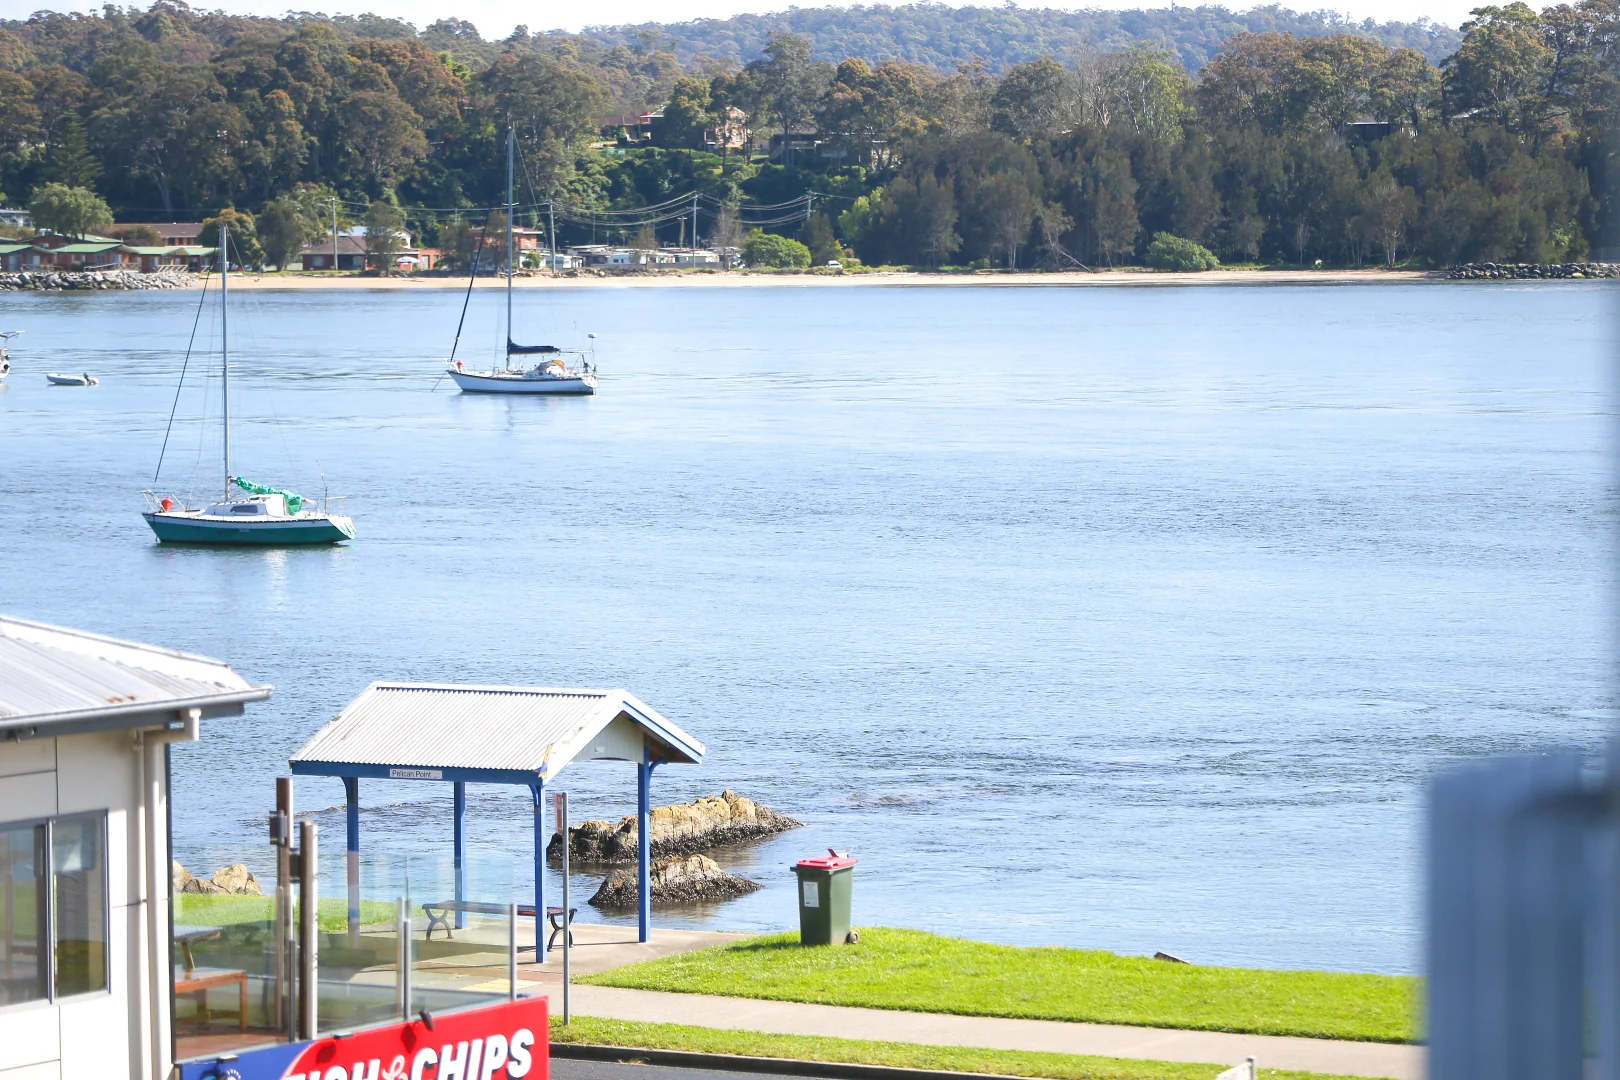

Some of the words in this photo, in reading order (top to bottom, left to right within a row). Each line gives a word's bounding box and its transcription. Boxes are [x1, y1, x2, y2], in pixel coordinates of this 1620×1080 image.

[392, 769, 415, 778] Pelican
[415, 770, 432, 778] Point
[410, 1028, 535, 1080] CHIPS
